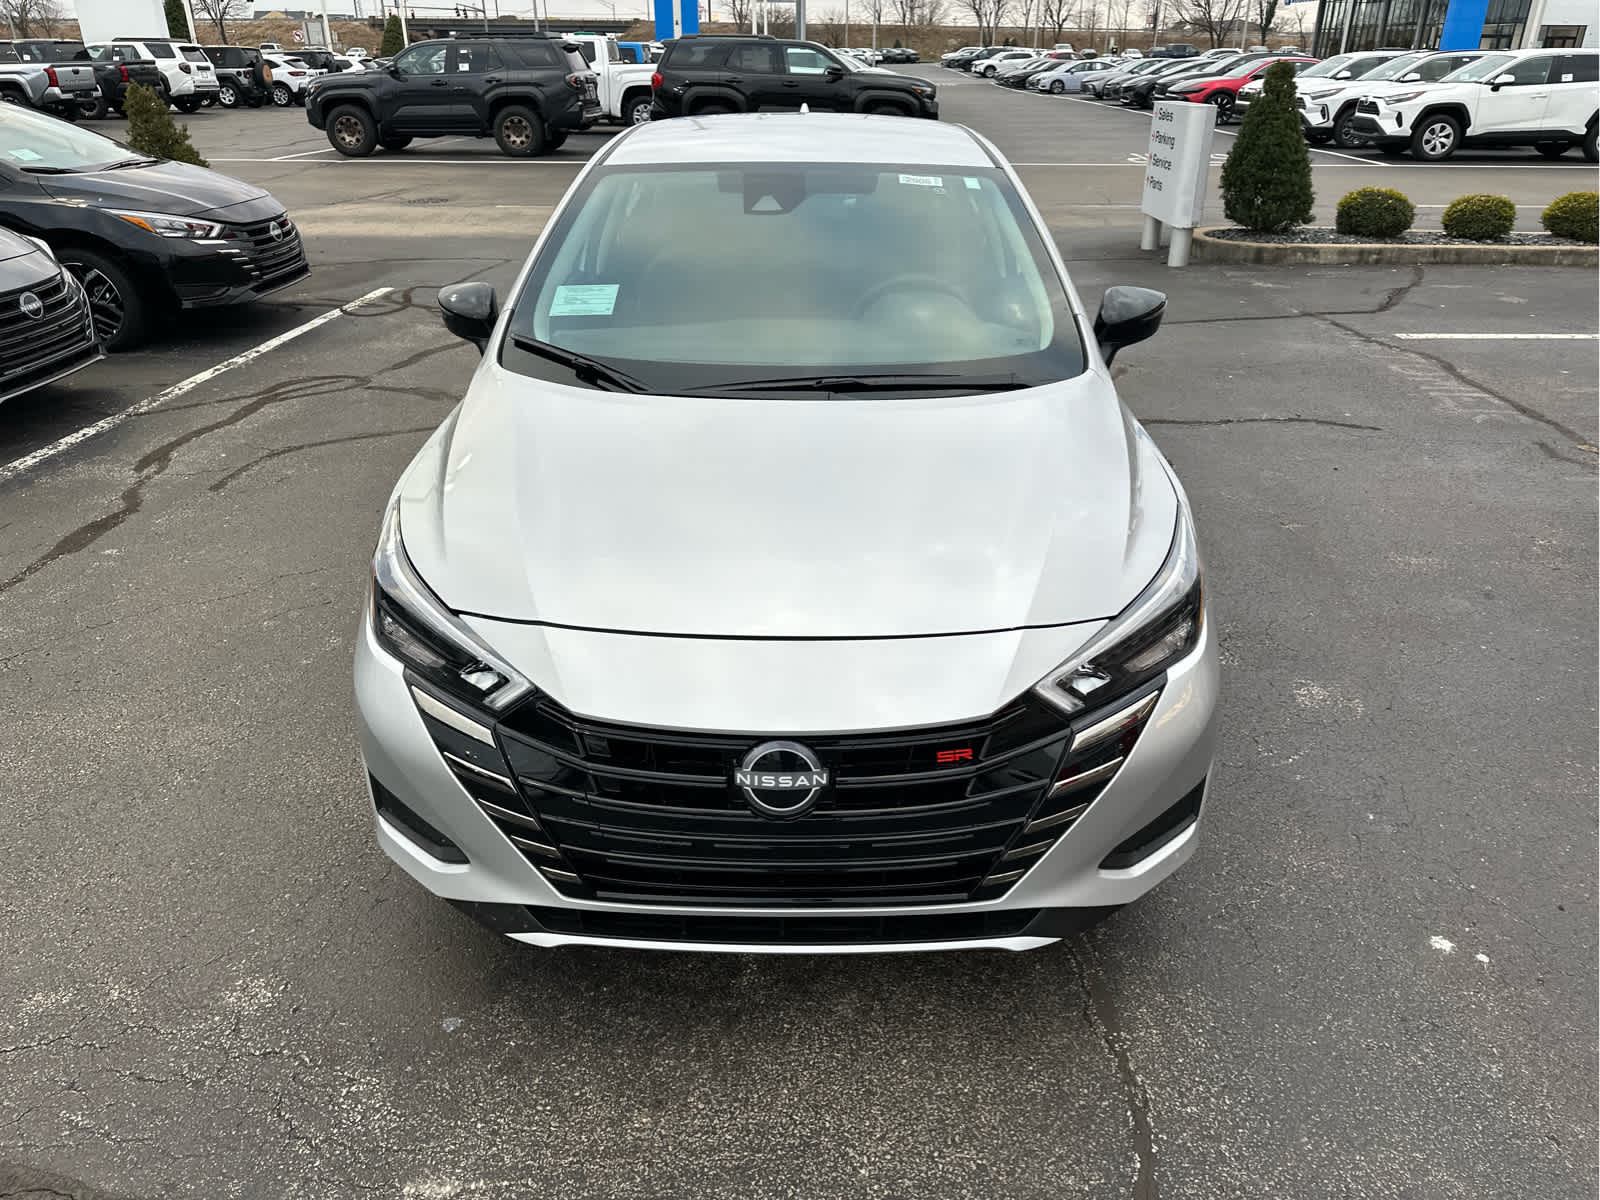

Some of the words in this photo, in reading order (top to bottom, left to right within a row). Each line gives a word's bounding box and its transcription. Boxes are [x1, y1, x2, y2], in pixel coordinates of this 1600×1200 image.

[1159, 107, 1174, 122] Sales
[1156, 131, 1175, 150] Parking
[1153, 153, 1172, 171] Service
[1149, 175, 1163, 191] Parts
[937, 748, 973, 763] SR
[735, 772, 828, 788] NISSAN
